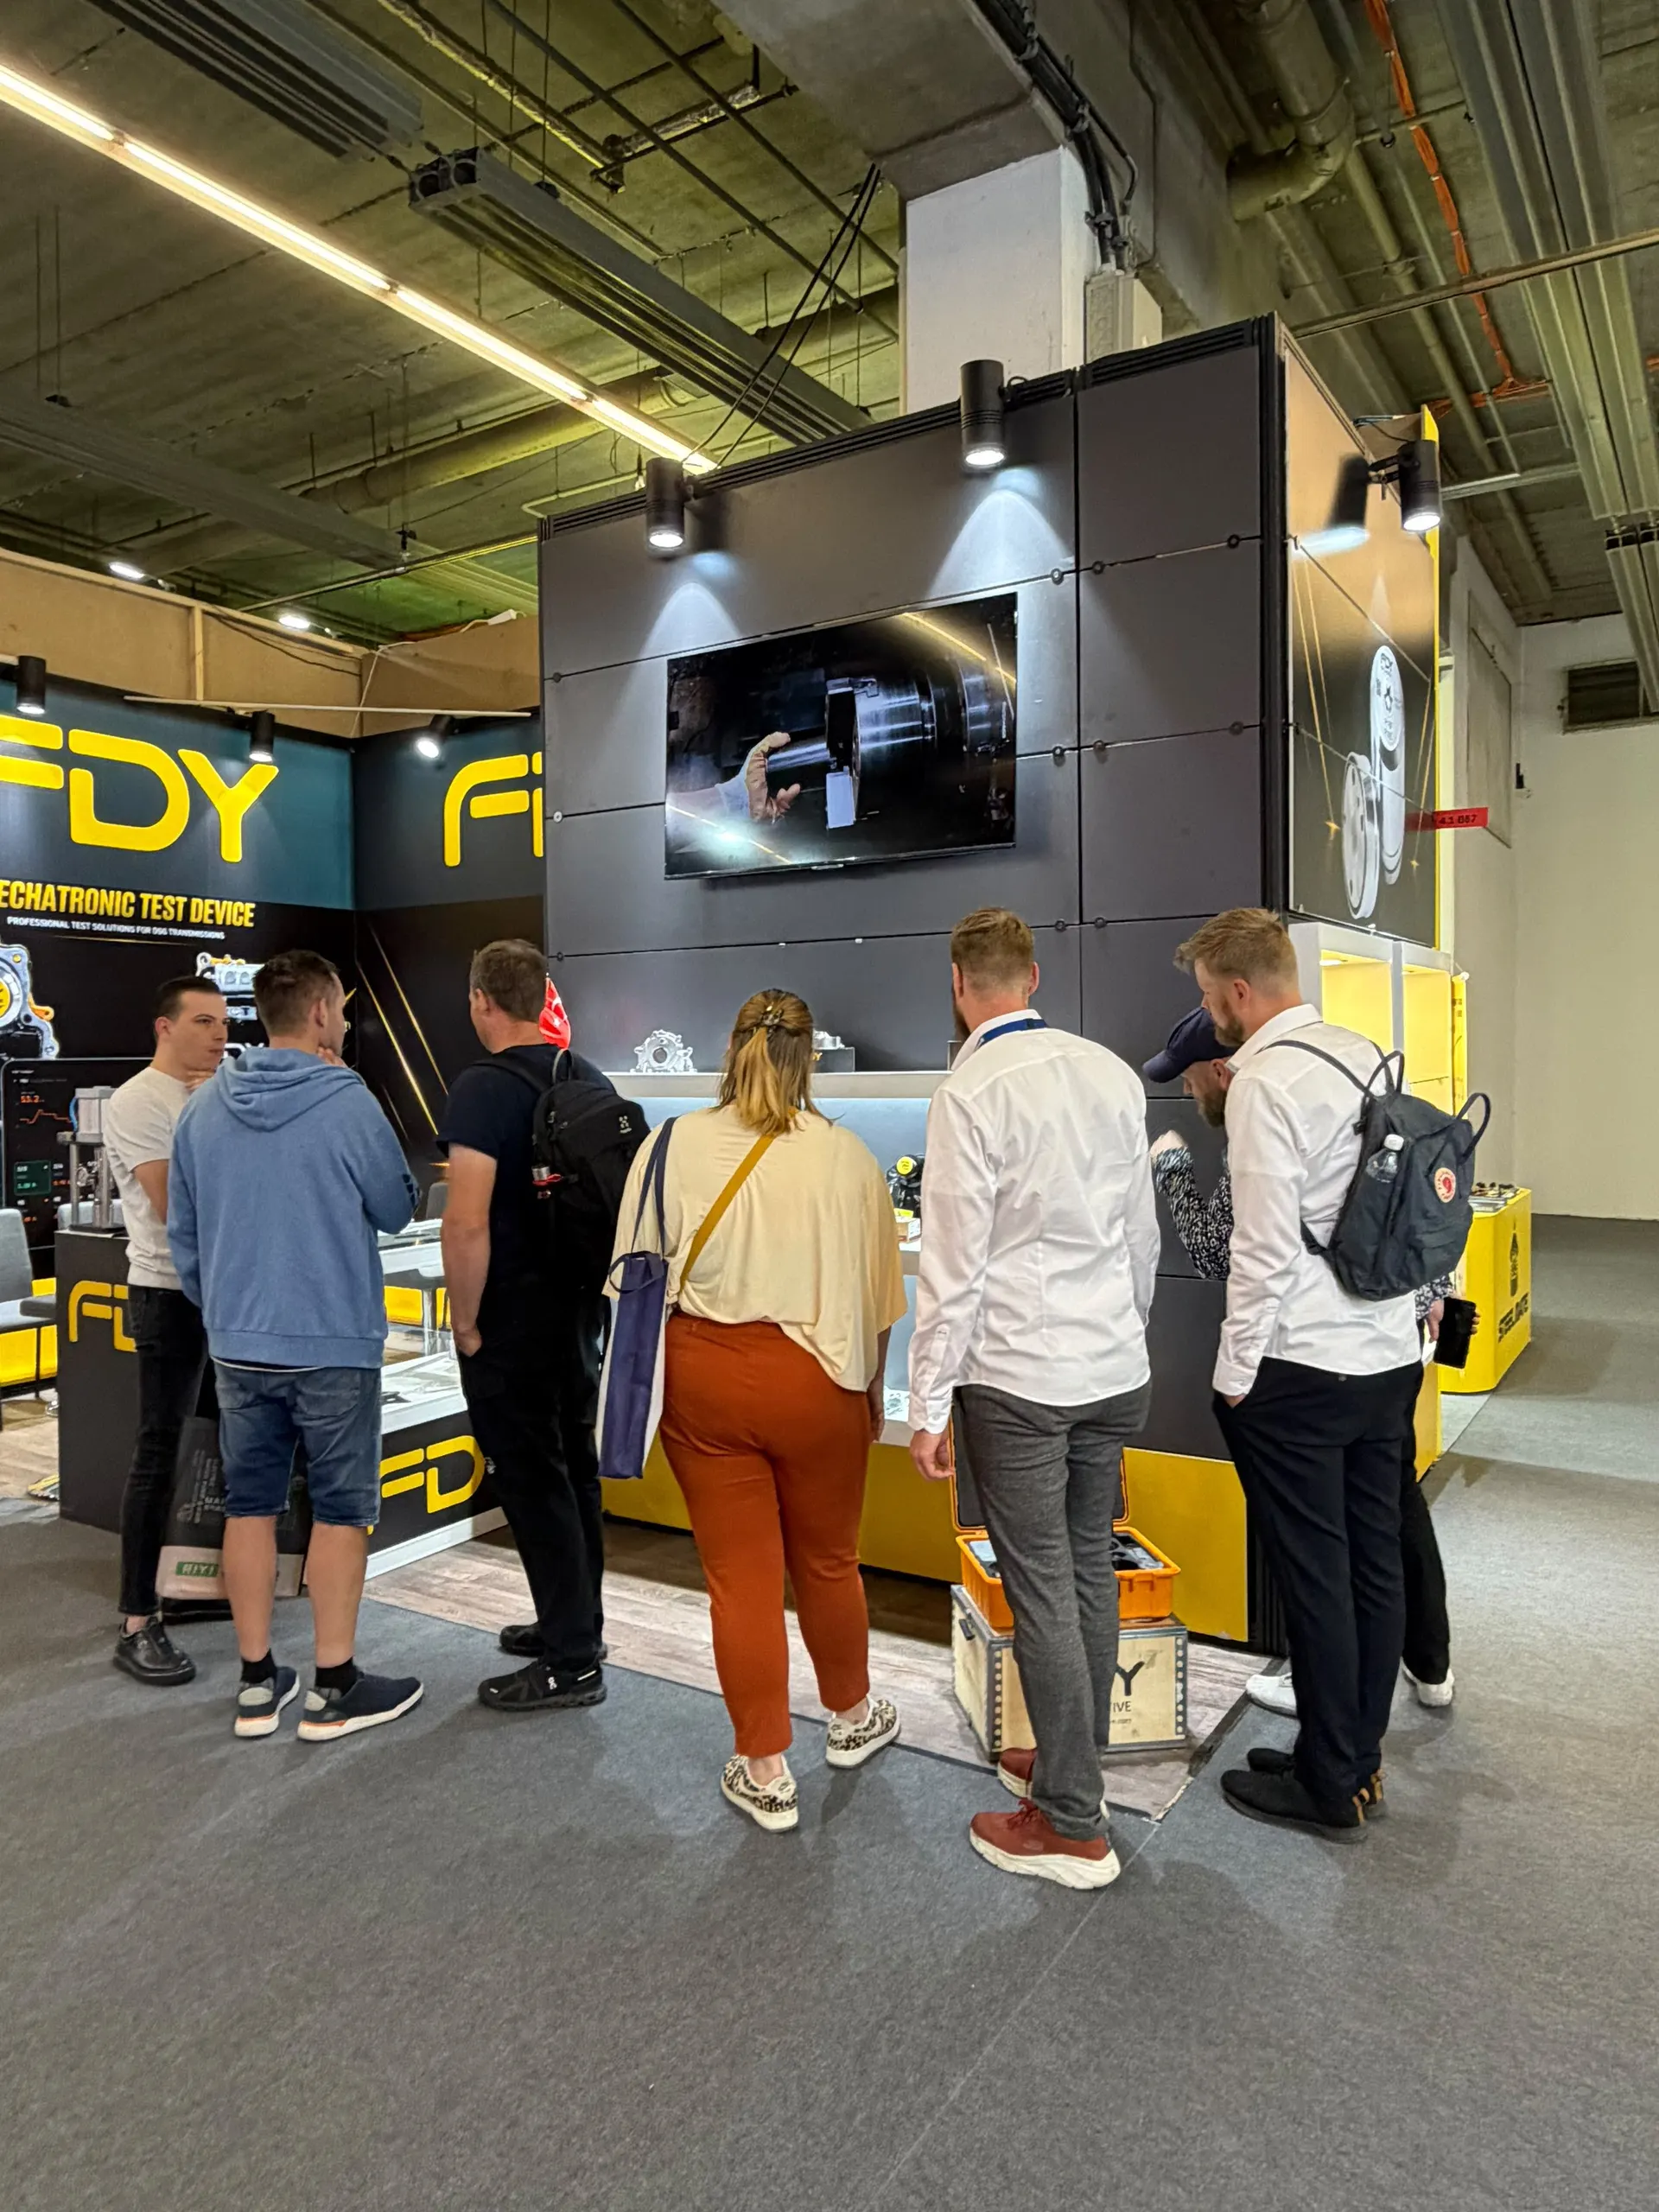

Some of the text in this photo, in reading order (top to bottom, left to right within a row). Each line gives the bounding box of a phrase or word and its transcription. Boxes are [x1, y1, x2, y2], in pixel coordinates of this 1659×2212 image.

[140, 893, 188, 922] TEST
[189, 898, 257, 927] DEVICE
[7, 916, 70, 929] PROFESSIONAL
[71, 921, 91, 931] TEST
[92, 923, 136, 934] SOLUTIONS
[137, 926, 151, 935] FOR
[168, 928, 226, 940] TRANSMISSIONS
[1111, 1700, 1132, 1713] IVE
